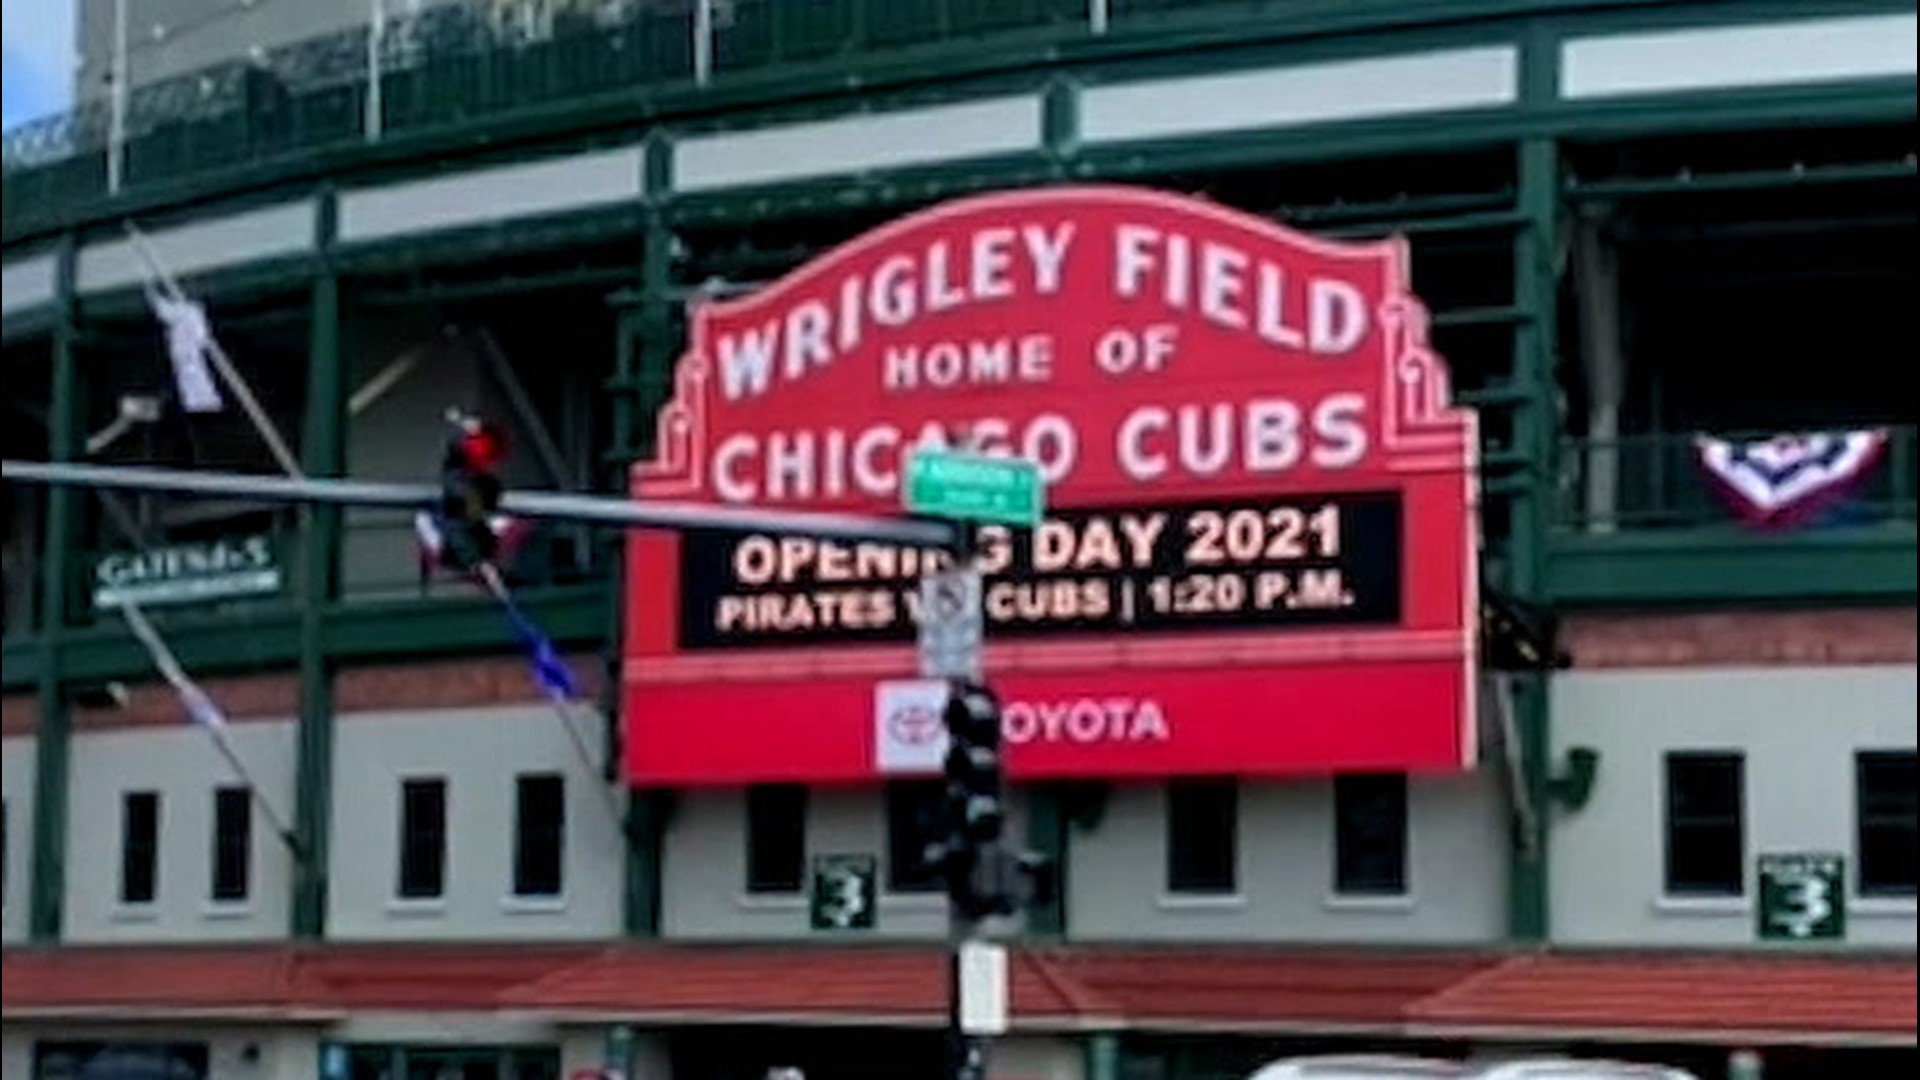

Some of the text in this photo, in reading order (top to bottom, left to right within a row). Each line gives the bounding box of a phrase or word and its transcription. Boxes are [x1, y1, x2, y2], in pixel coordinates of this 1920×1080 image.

[716, 220, 1369, 400] WRIGLEY FIELD
[882, 323, 1179, 391] HOME OF
[1116, 392, 1369, 481] CUBS
[1031, 513, 1167, 572] DAY
[1186, 504, 1342, 562] 2021
[715, 590, 897, 632] PIRATES
[984, 577, 1110, 621] CUBS
[1147, 573, 1245, 614] 1:20
[1254, 565, 1355, 609] P.M.
[1001, 697, 1169, 744] OYOTA
